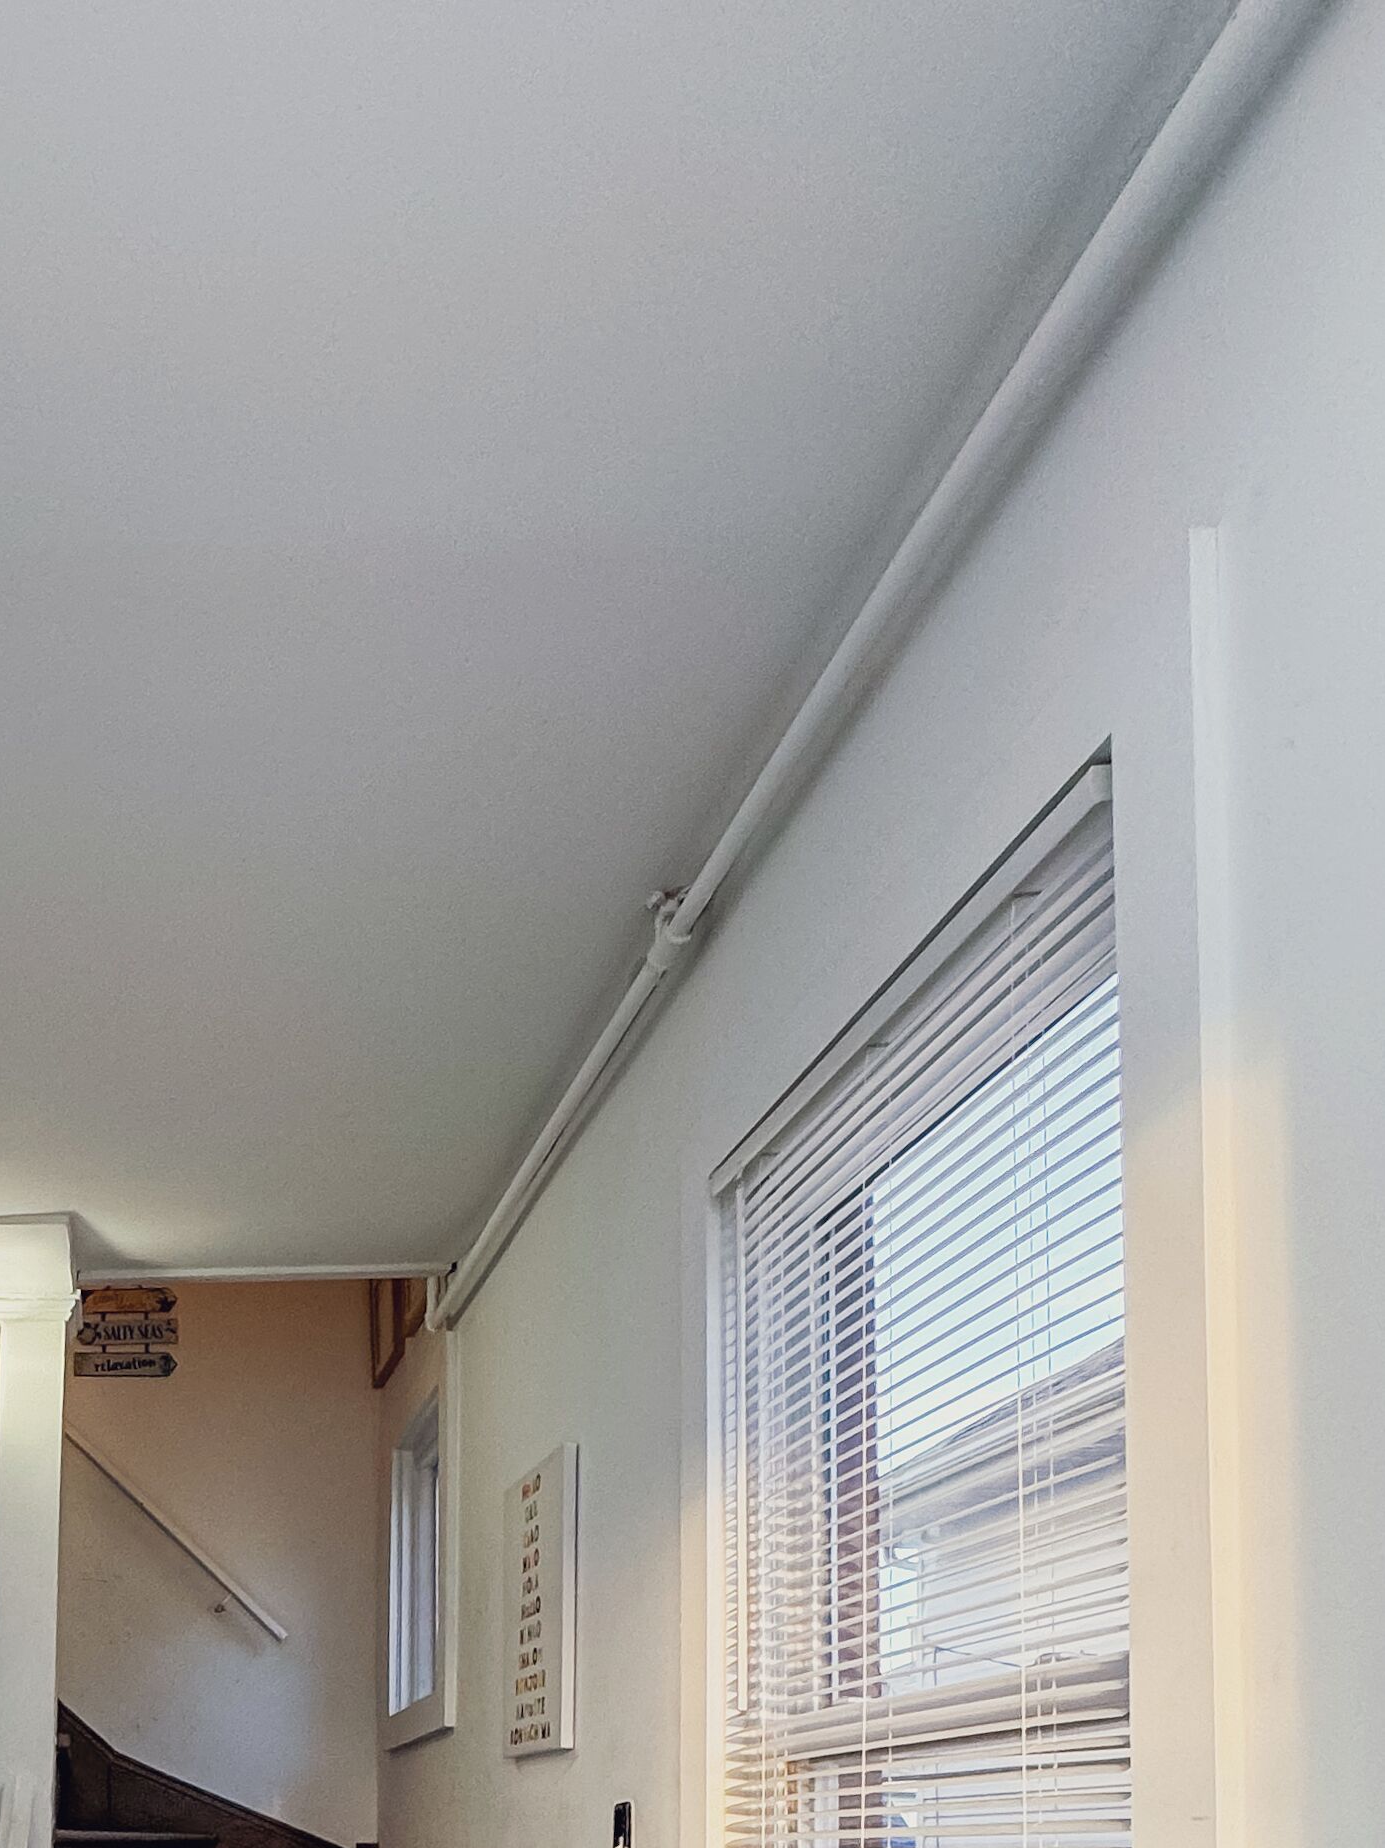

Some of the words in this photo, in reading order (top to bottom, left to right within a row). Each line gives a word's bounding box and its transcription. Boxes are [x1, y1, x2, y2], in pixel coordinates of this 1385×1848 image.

[103, 1323, 134, 1341] SALTY
[138, 1322, 164, 1340] SEAS
[94, 1357, 156, 1372] relaxation
